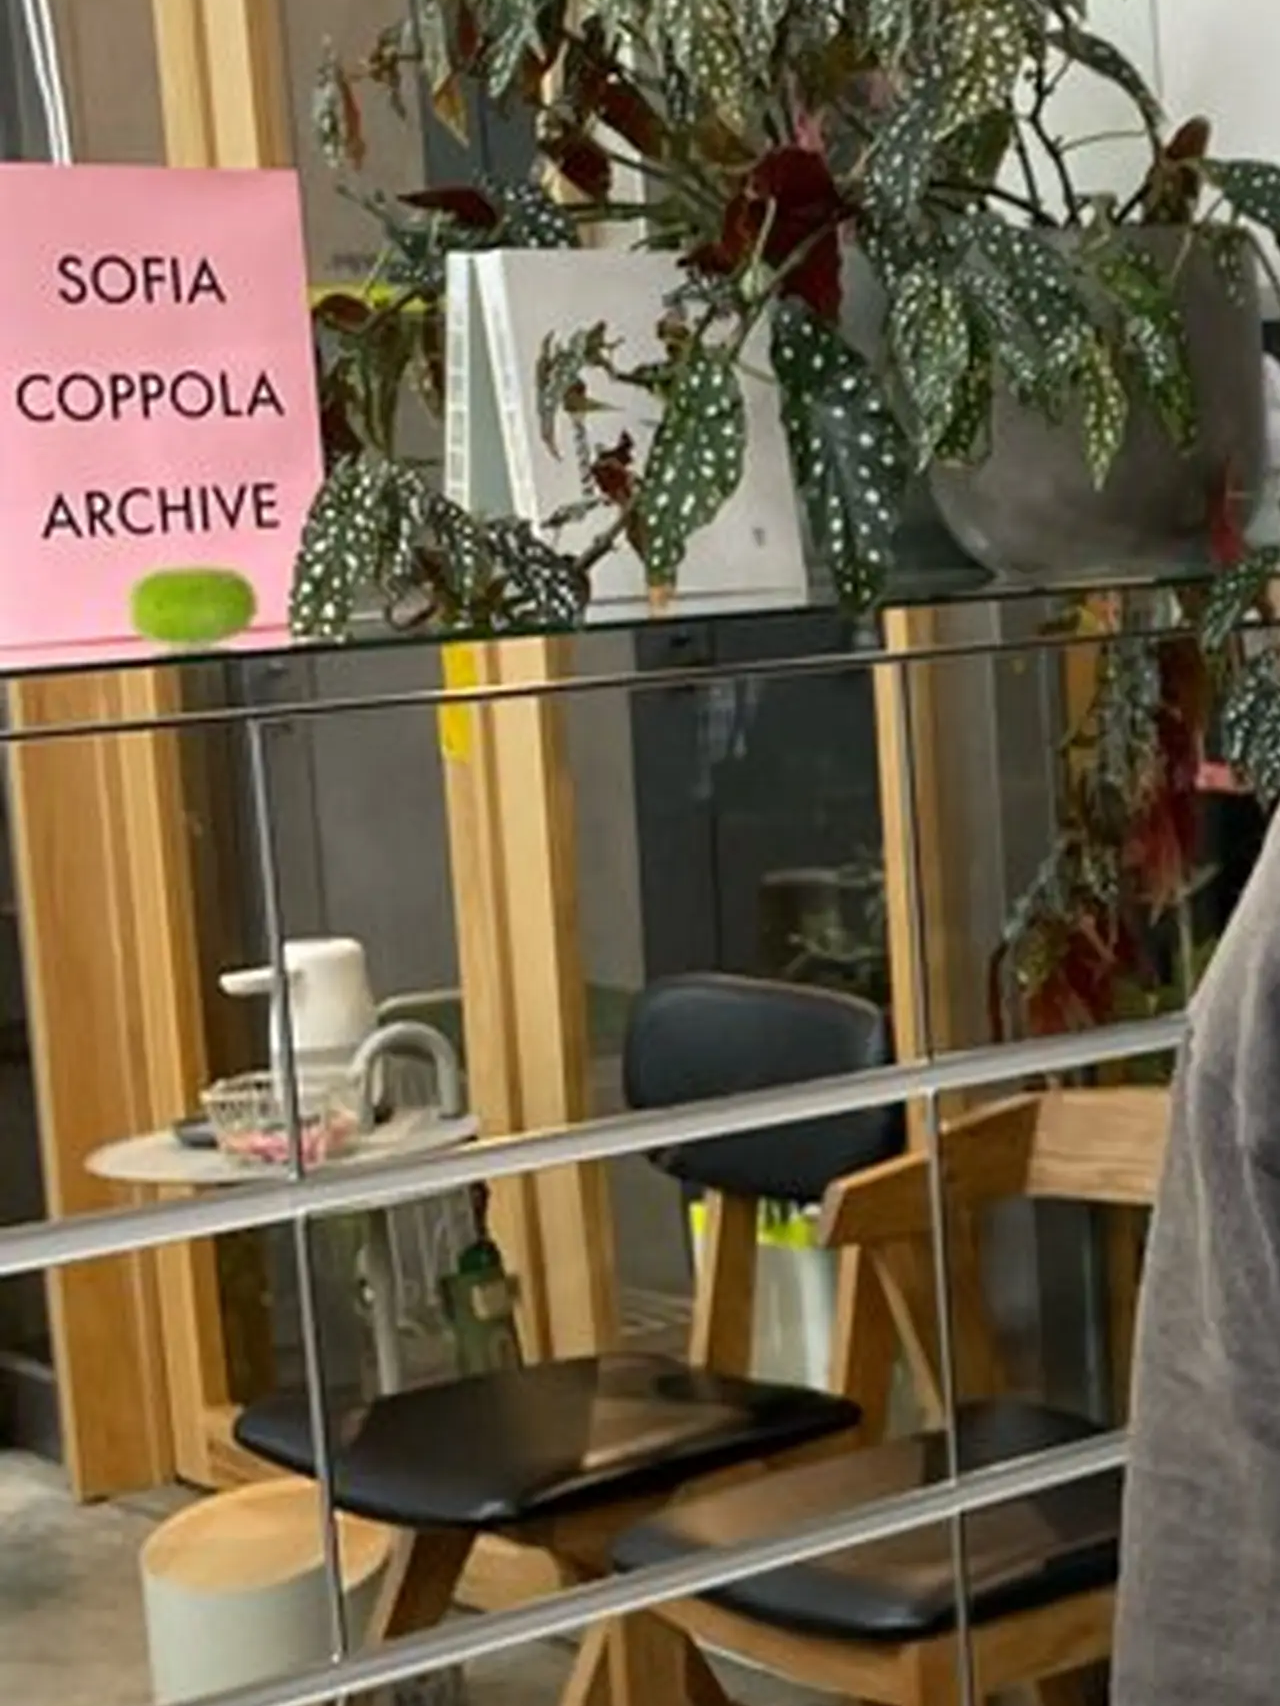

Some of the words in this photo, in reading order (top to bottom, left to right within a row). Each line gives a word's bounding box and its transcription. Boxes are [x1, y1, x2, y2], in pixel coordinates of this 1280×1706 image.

[57, 255, 227, 304] SOFIA
[16, 370, 285, 422] COPPOLA
[41, 483, 280, 539] ARCHIVE
